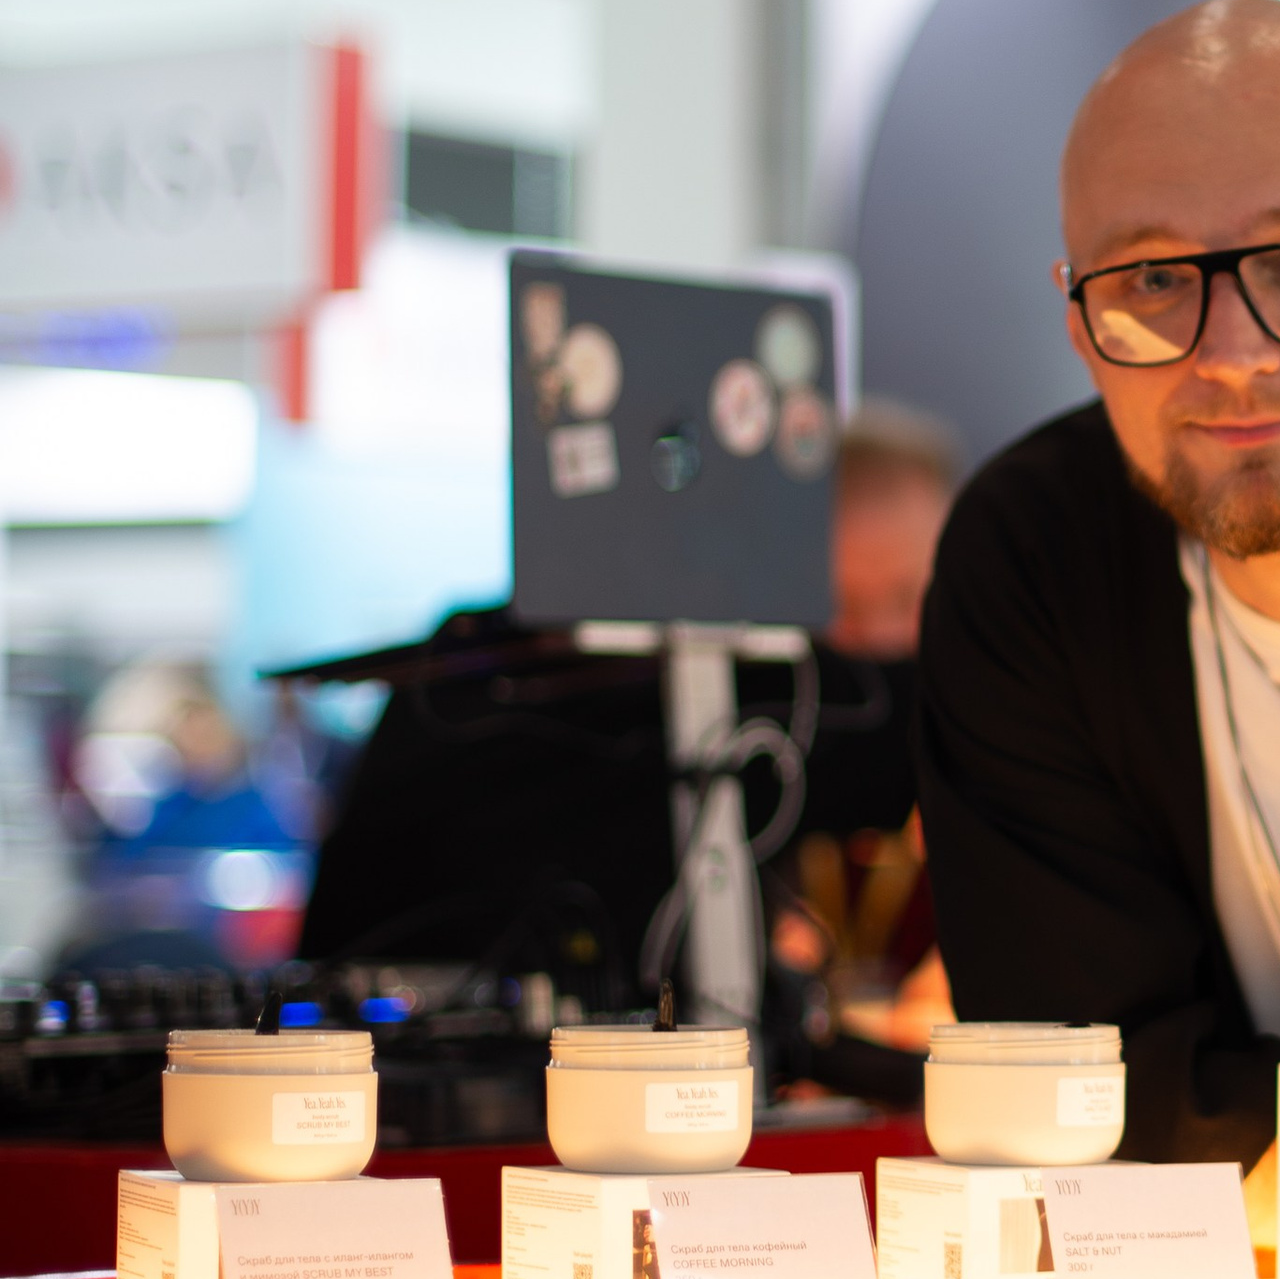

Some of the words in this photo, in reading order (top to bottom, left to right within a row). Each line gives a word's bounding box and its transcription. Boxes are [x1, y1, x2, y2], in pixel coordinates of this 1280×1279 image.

[1063, 1232, 1094, 1243] Скраб
[1096, 1232, 1114, 1242] для
[1116, 1232, 1137, 1240] тела
[1147, 1229, 1208, 1240] макадамией
[671, 1244, 704, 1255] Скраб
[706, 1245, 725, 1254] для
[753, 1241, 807, 1253] кофейный
[1065, 1247, 1089, 1257] SALT
[1092, 1247, 1099, 1256] &
[1101, 1246, 1123, 1256] NUT
[237, 1255, 272, 1266] Скраб
[275, 1256, 295, 1266] для
[297, 1255, 321, 1263] тела
[324, 1255, 330, 1263] с
[333, 1252, 414, 1262] иланг-илангом
[673, 1259, 718, 1269] COFFEE
[720, 1257, 774, 1268] MORNING
[303, 1268, 341, 1279] SCRUB
[345, 1267, 362, 1278] MY
[365, 1266, 394, 1277] BEST
[1068, 1262, 1087, 1272] 300
